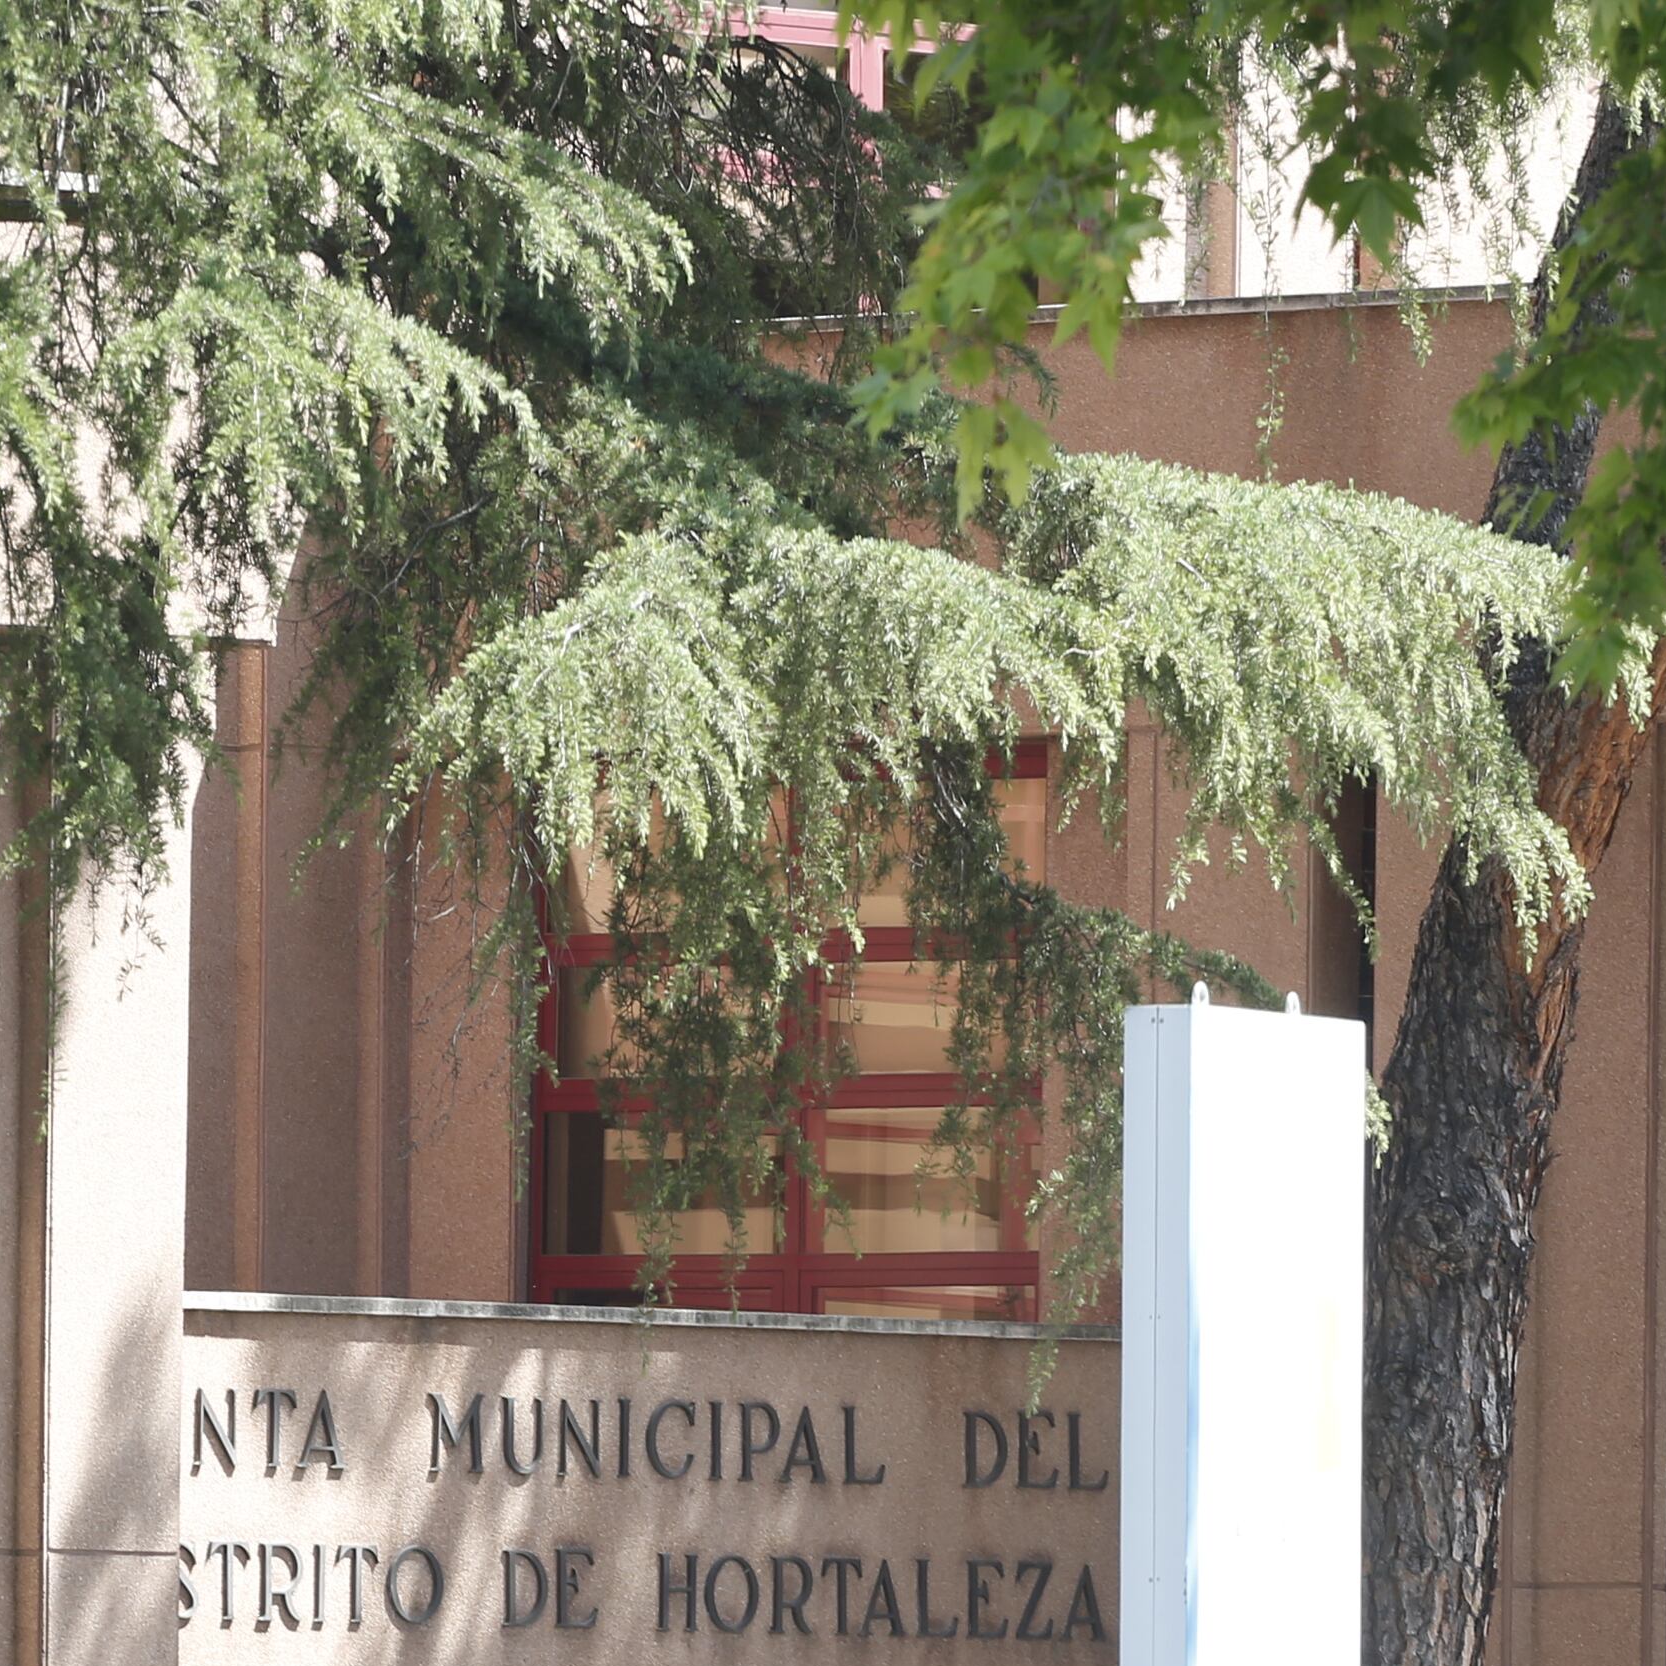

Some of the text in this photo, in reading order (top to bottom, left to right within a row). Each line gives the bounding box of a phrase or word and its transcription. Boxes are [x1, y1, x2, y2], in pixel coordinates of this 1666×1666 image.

[427, 1391, 886, 1485] MUNICIPAL
[964, 1407, 1109, 1492] DEL
[502, 1547, 599, 1630] DE
[656, 1549, 1107, 1641] HORTALEZA
